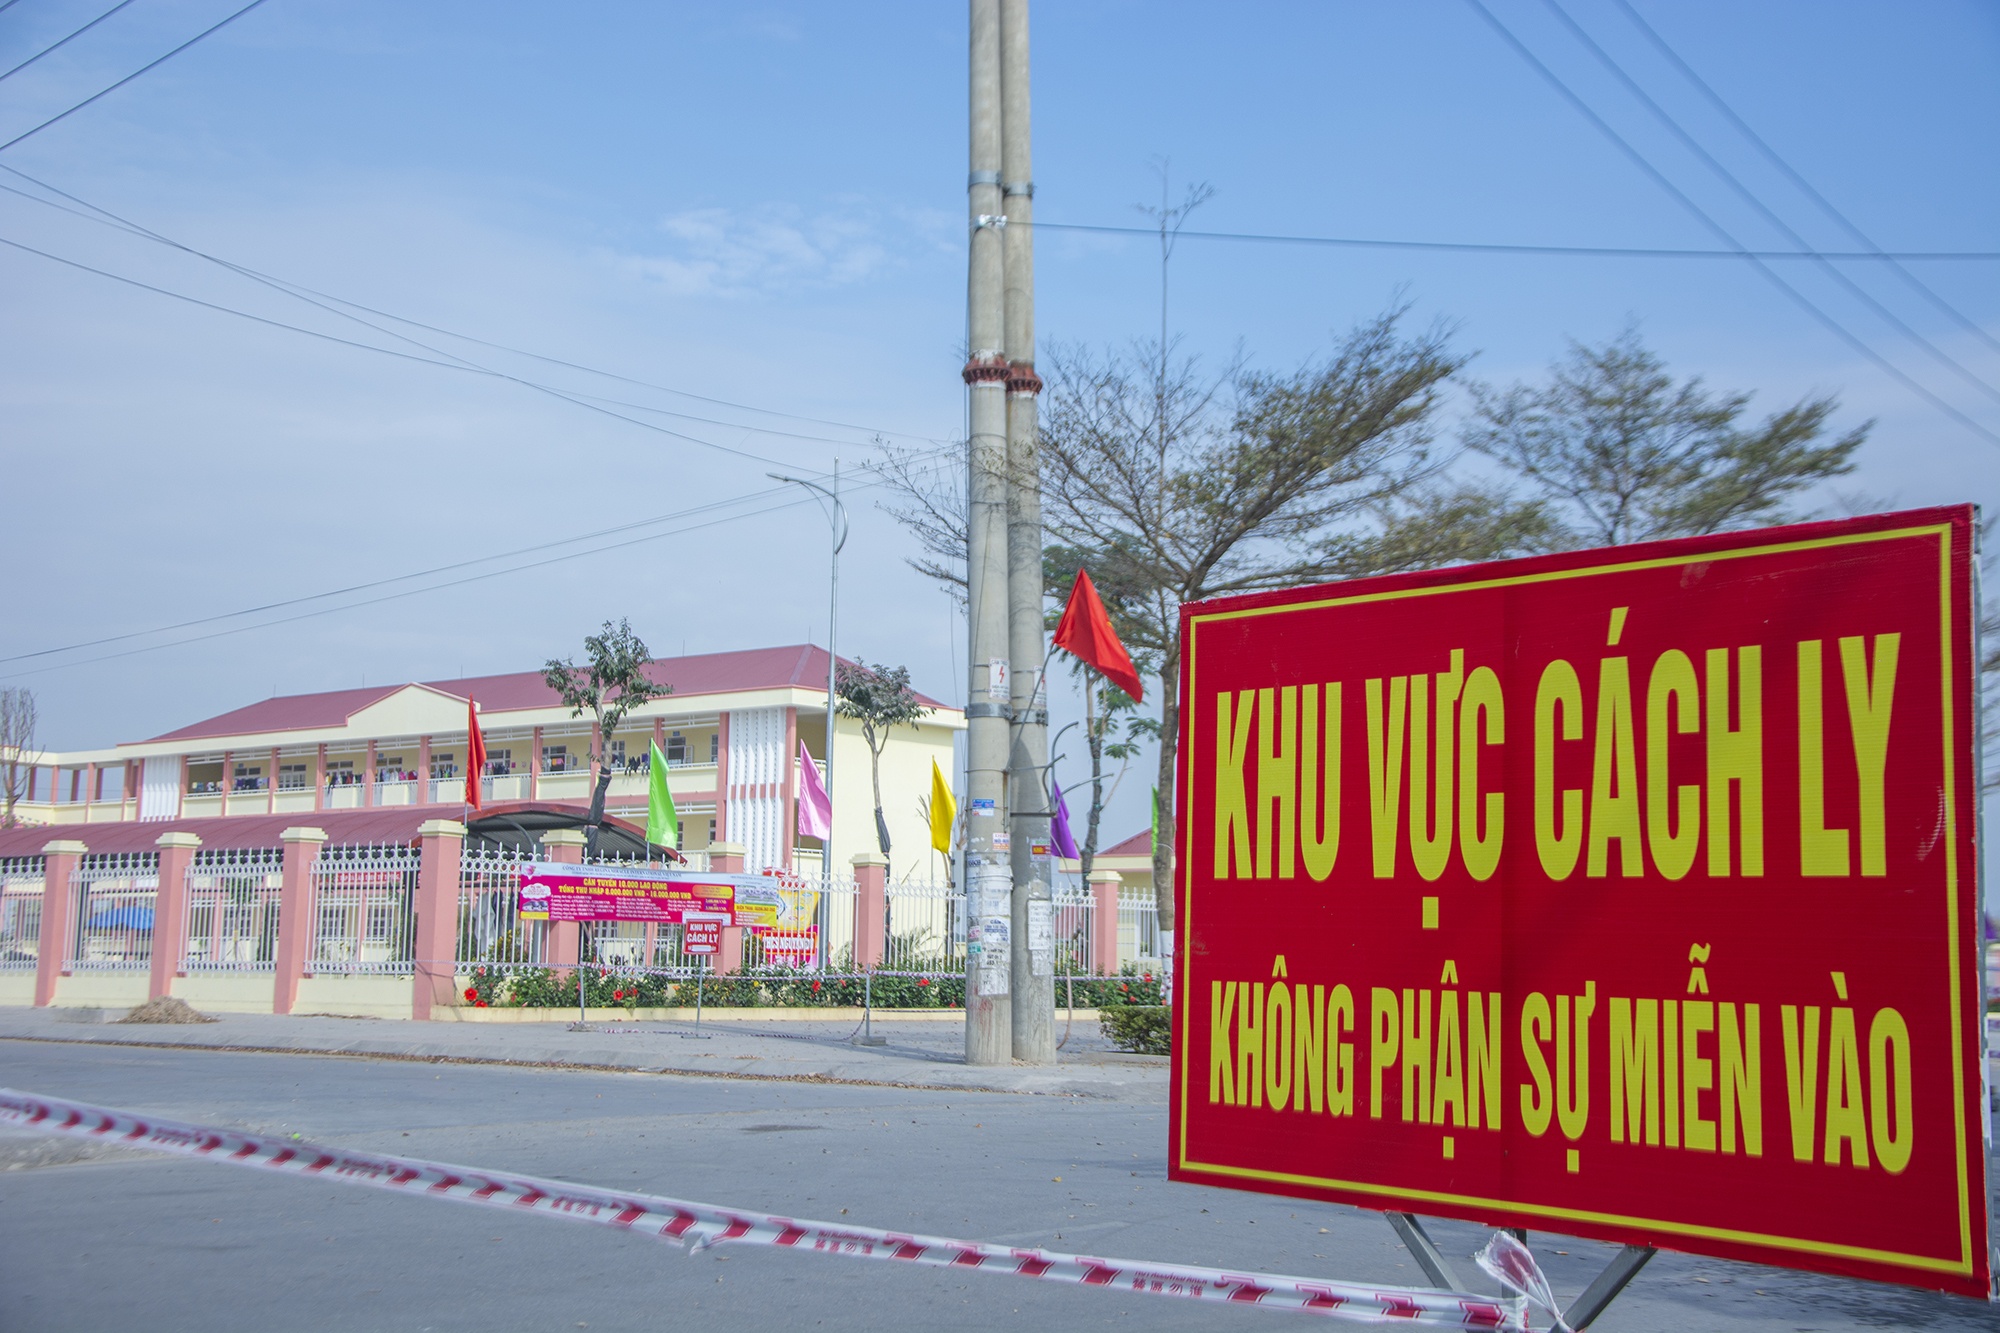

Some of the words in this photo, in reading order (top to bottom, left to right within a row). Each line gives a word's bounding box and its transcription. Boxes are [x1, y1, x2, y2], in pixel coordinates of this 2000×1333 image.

[1213, 681, 1342, 883] KHU
[1365, 648, 1505, 930] VỰC
[1534, 606, 1764, 882] CÁCH
[1798, 632, 1902, 877] LY
[687, 932, 707, 943] CÁCH
[708, 934, 718, 943] LY
[689, 923, 703, 931] KHU
[704, 923, 718, 932] VỰC
[1209, 954, 1354, 1117] KHÔNG
[1370, 960, 1501, 1159] PHẬN
[1520, 981, 1596, 1173] SỰ
[1609, 943, 1763, 1157] MIỄN
[1781, 972, 1913, 1174] VÀO
